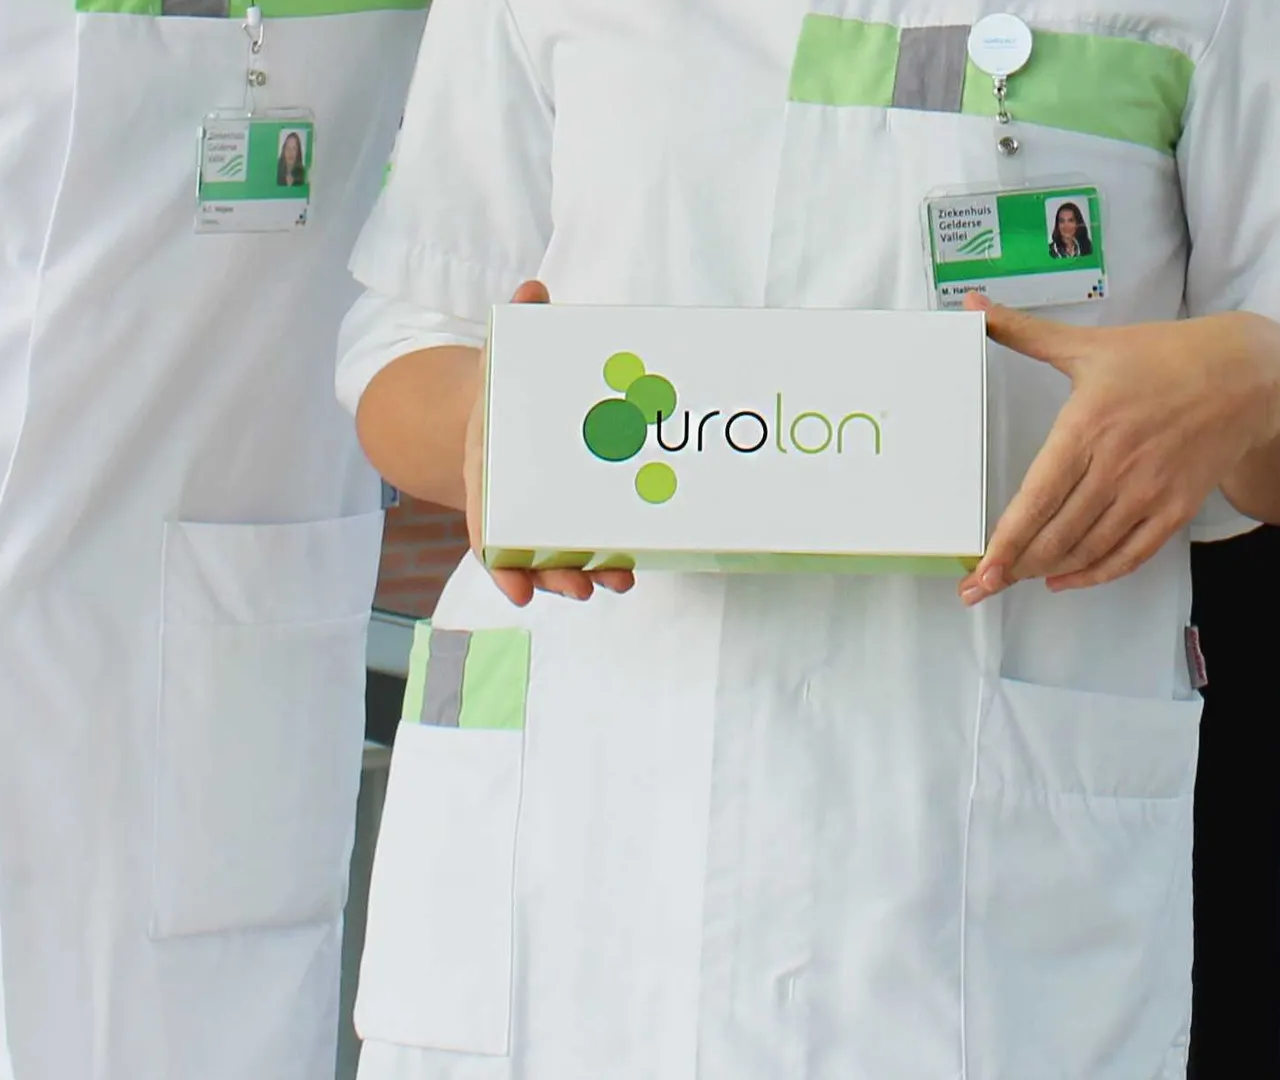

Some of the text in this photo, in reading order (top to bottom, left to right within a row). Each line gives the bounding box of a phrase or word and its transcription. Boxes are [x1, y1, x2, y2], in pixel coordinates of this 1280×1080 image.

[938, 205, 992, 219] Ziekenhuis
[939, 220, 982, 231] Gelderse
[940, 231, 969, 243] Vallei
[657, 392, 881, 455] urolon
